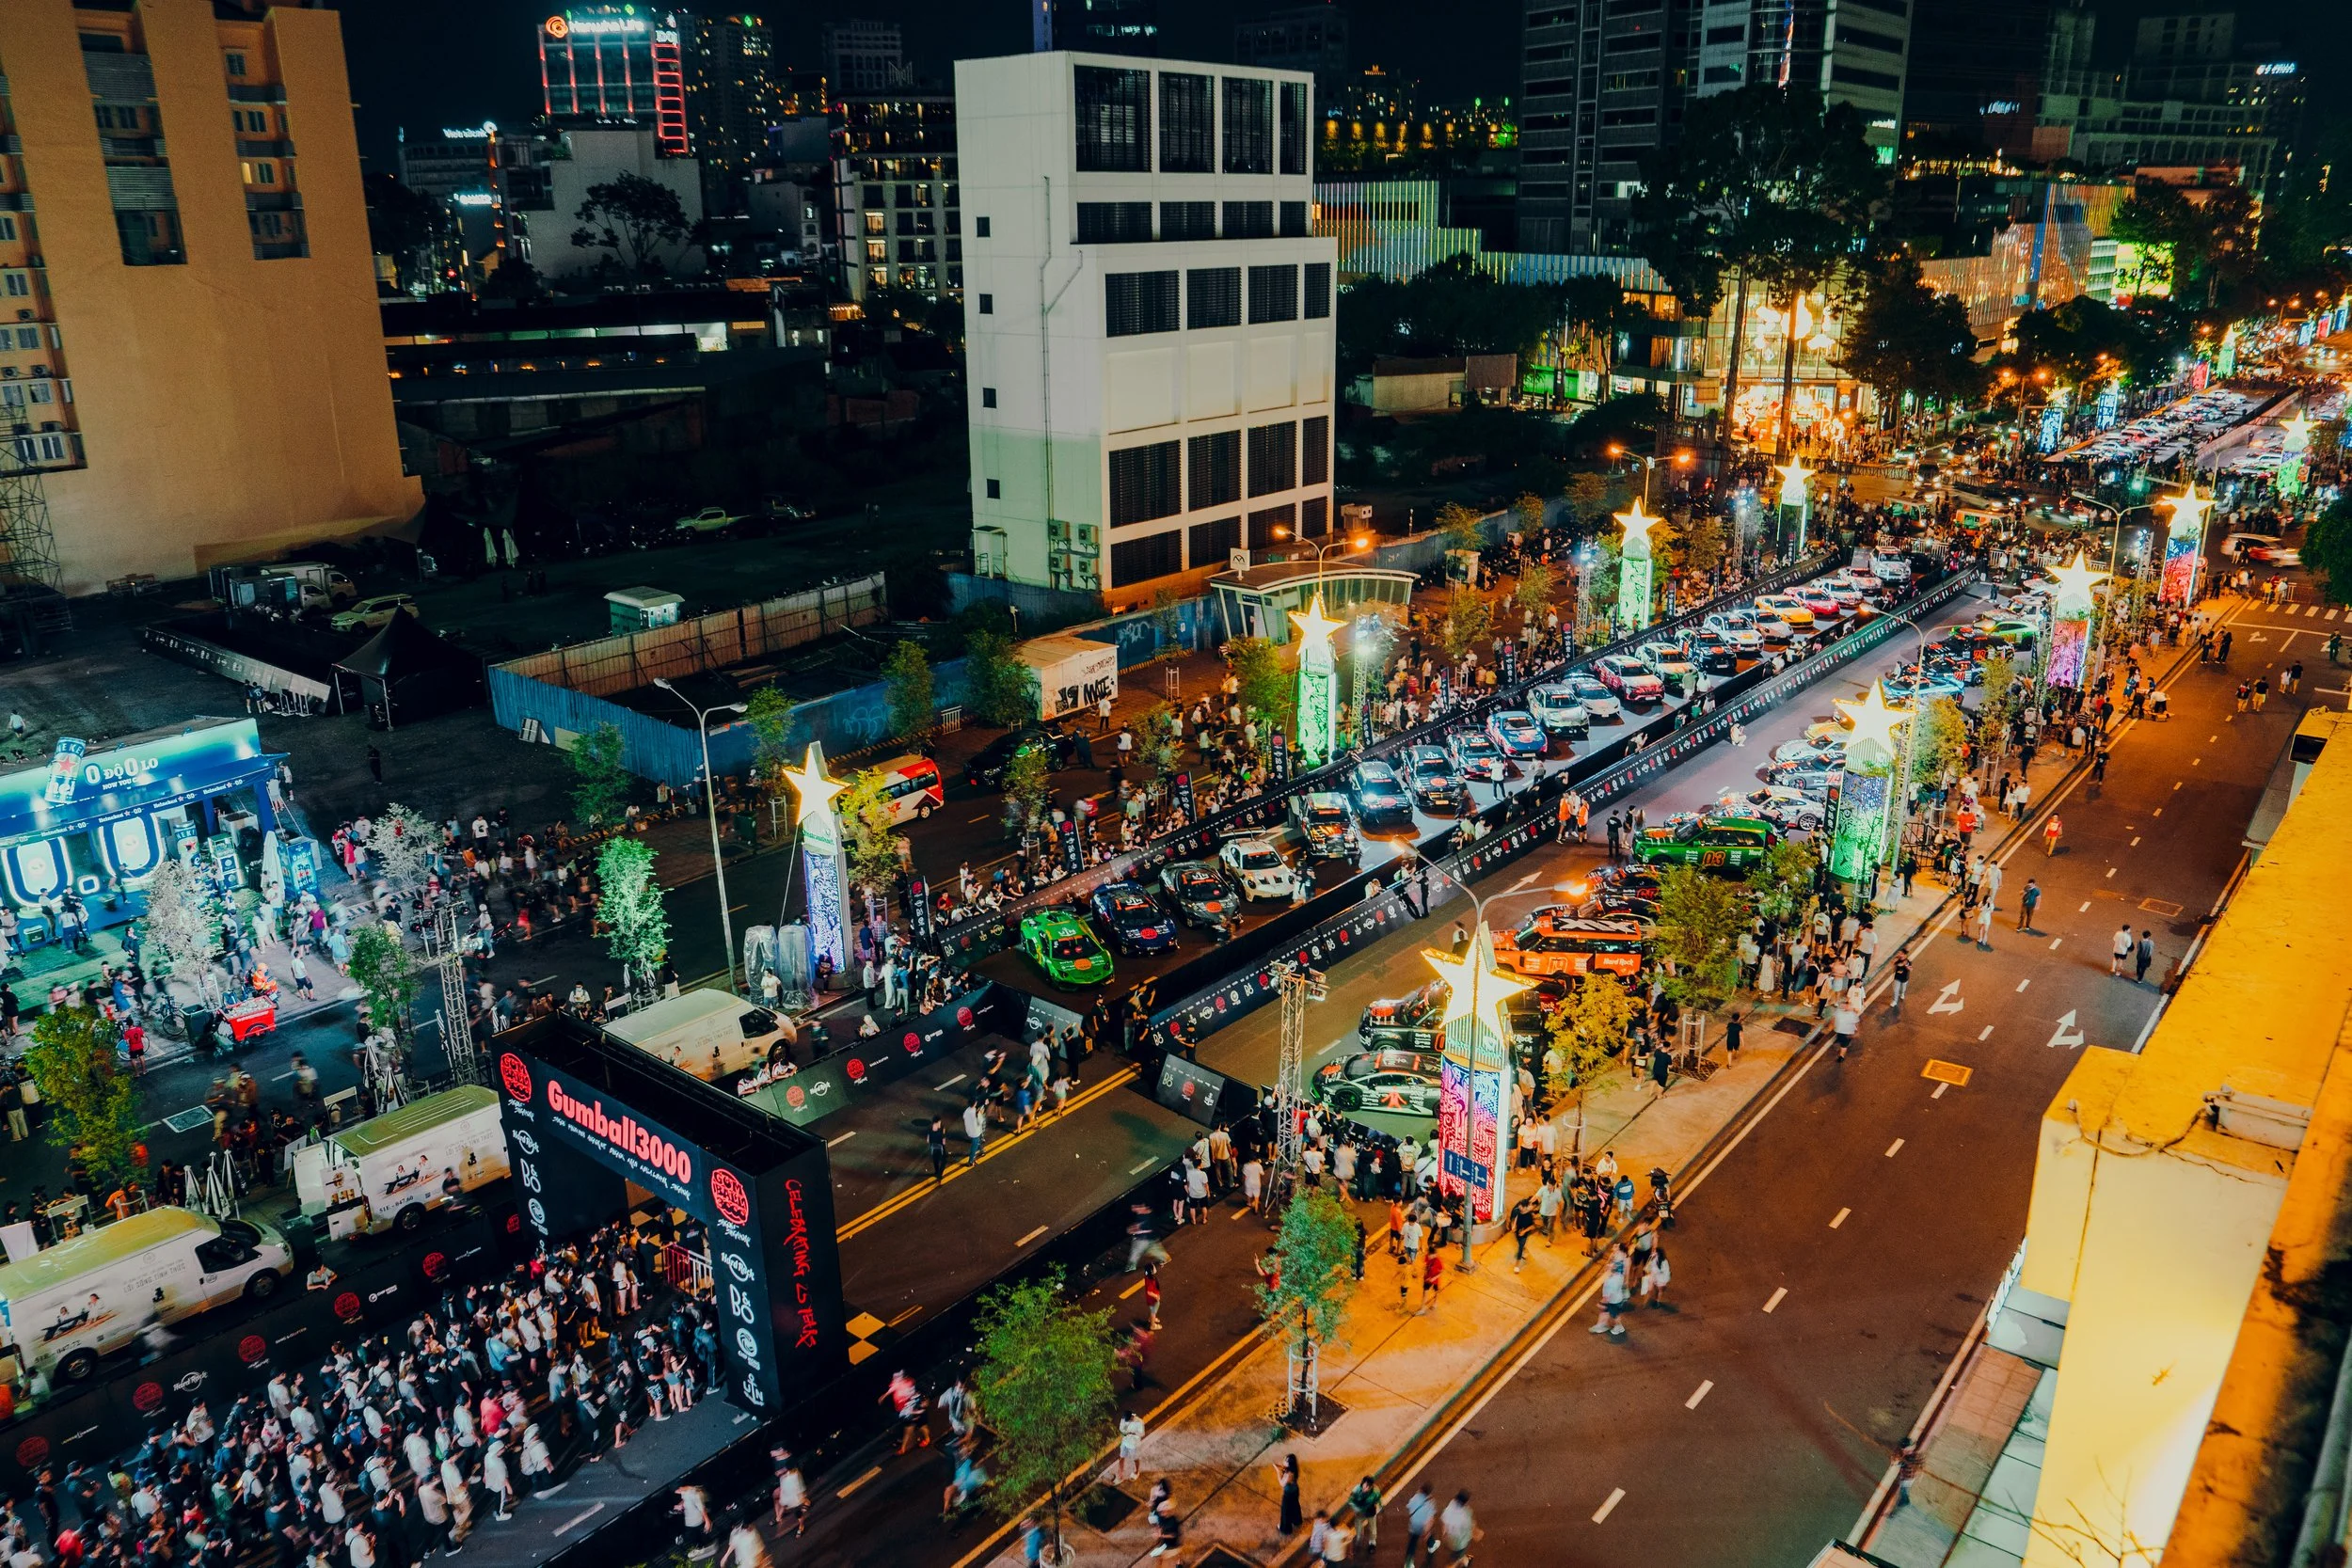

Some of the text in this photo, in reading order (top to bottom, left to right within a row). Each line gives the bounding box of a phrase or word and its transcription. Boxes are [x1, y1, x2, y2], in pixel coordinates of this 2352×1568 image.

[1603, 958, 1634, 967] Hard Rock
[548, 1080, 691, 1184] Gumball3000
[721, 1252, 755, 1281] Hard Rock
[172, 1370, 209, 1392] Hard Rock
